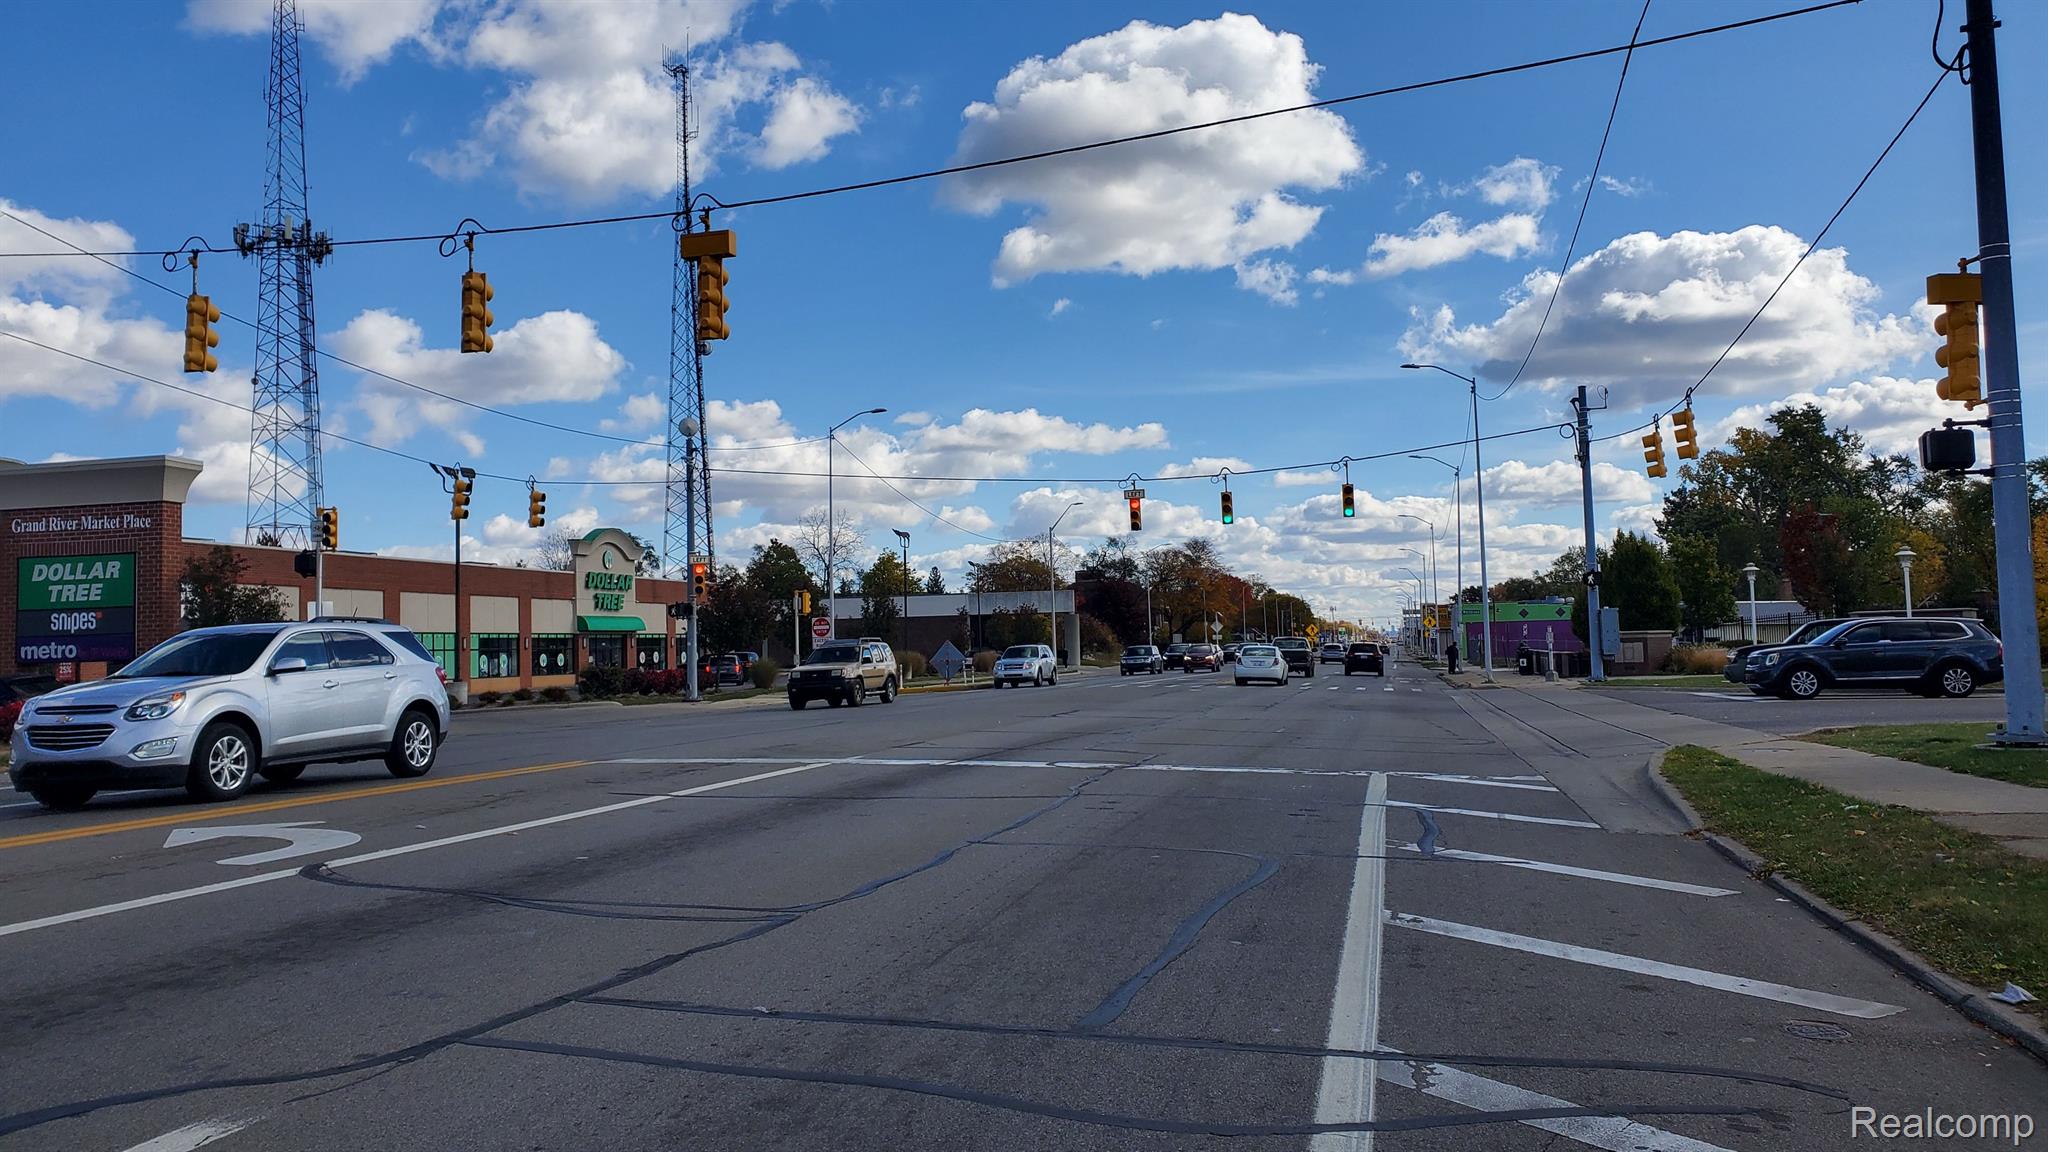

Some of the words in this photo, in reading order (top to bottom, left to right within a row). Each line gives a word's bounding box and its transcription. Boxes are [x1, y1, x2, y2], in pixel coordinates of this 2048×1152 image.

[11, 518, 46, 533] Grand
[49, 517, 78, 531] River
[81, 515, 120, 530] Market
[123, 514, 151, 528] Place
[31, 561, 121, 582] DOLLAR
[586, 572, 633, 591] DOLLAR
[48, 583, 103, 602] TREE
[594, 593, 625, 611] TREE
[50, 612, 97, 634] snipes
[20, 642, 77, 659] metro
